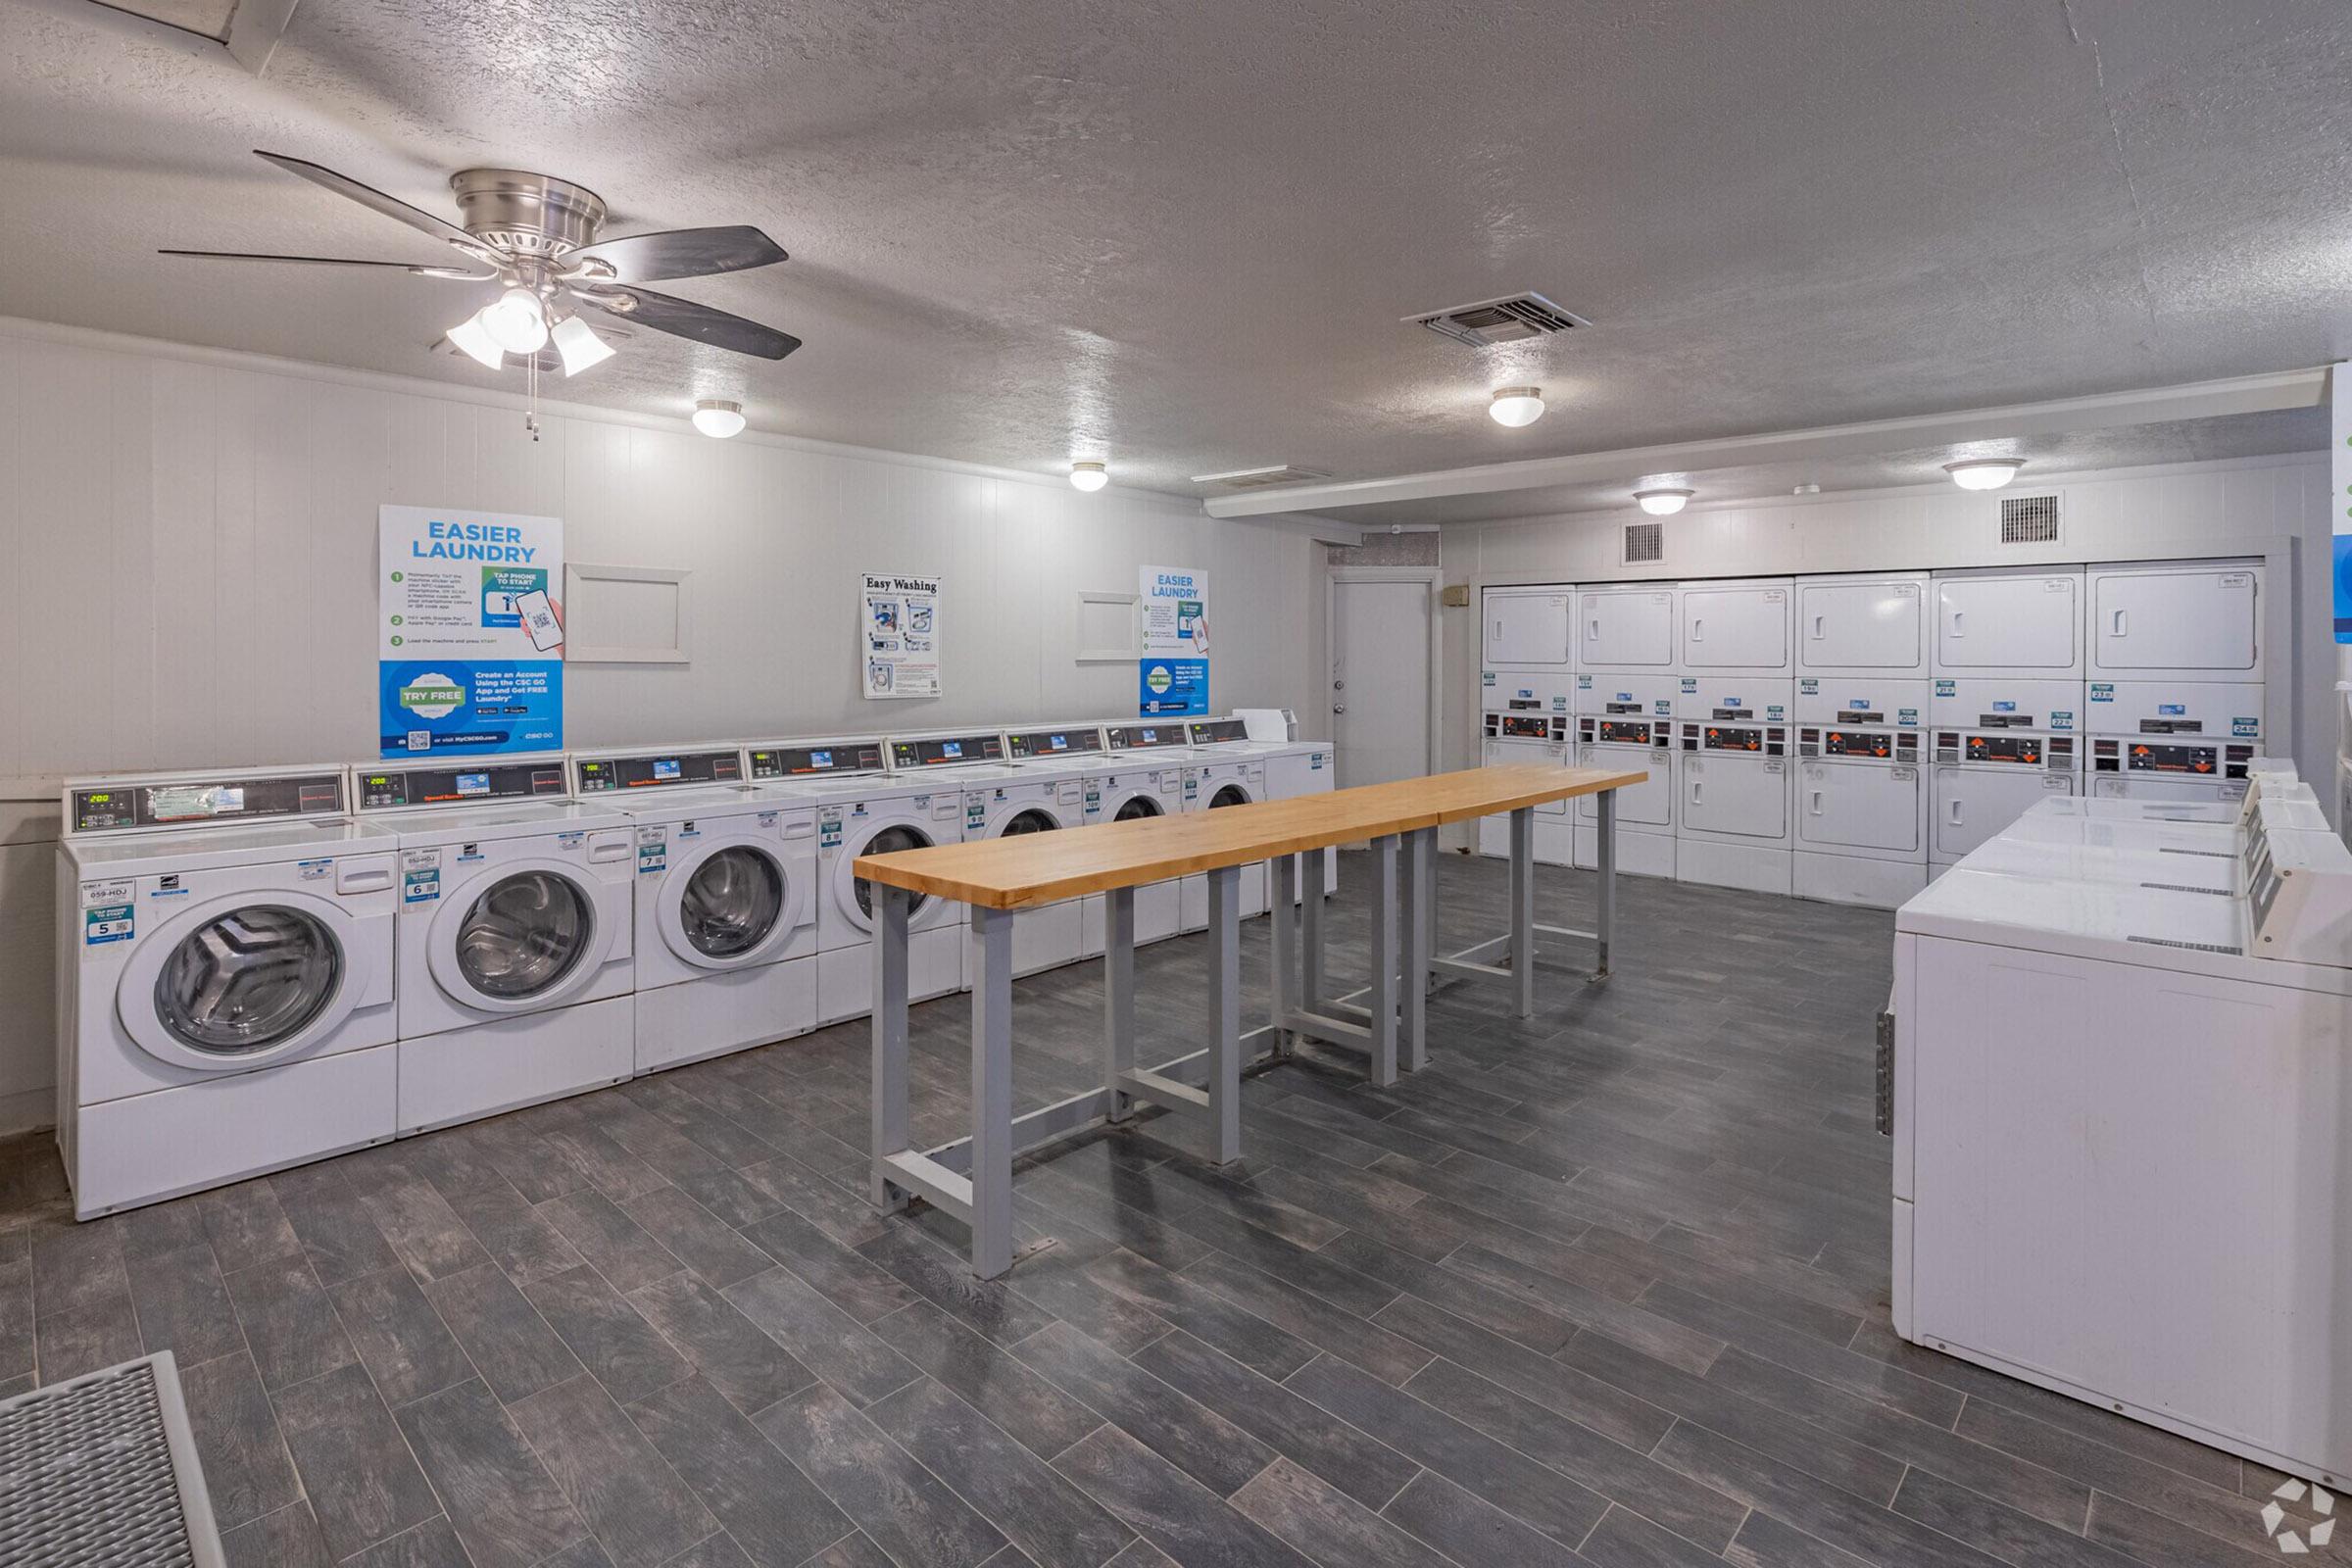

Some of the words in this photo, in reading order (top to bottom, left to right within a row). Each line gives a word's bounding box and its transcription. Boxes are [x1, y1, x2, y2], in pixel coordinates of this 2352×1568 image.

[429, 521, 521, 544] EASIER
[413, 541, 536, 563] LAUNDRY
[866, 577, 892, 591] Easy
[894, 578, 937, 594] Washing
[1157, 574, 1193, 587] EASIER
[1152, 586, 1199, 599] LAUNDRY
[403, 692, 428, 701] TRY
[431, 691, 462, 700] FREE
[647, 858, 652, 866] 7
[414, 885, 421, 894] 6
[99, 923, 109, 934] 5
